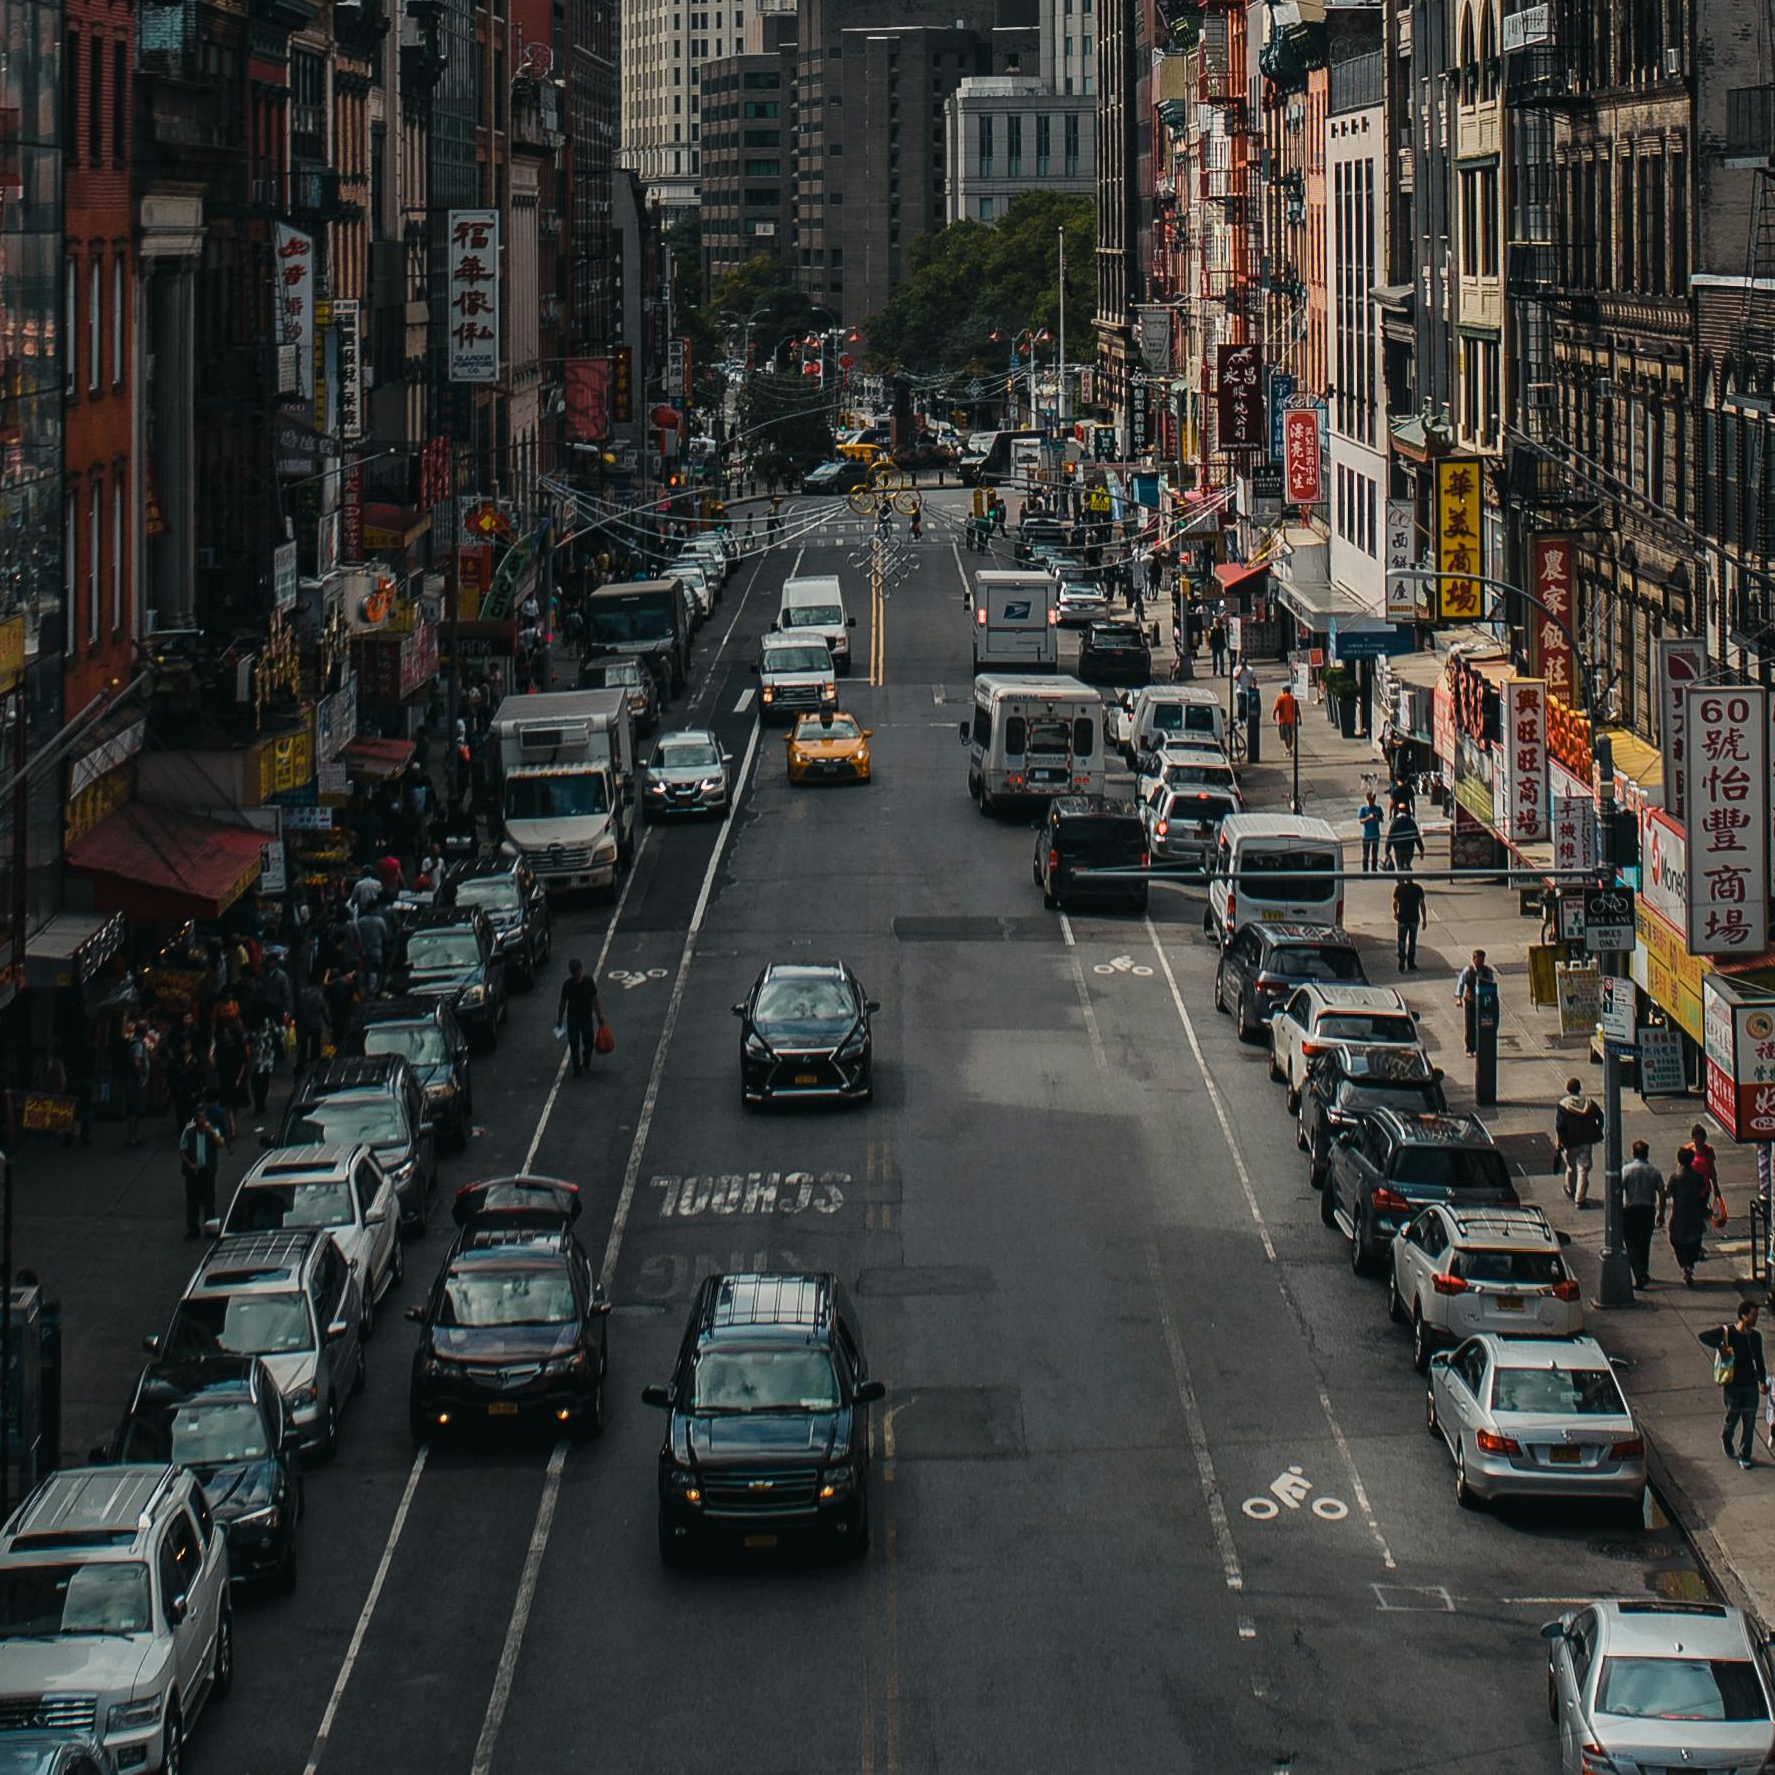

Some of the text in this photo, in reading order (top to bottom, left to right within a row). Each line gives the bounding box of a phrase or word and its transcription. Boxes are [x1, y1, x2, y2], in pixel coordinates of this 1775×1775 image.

[1444, 469, 1479, 615] 華美商場
[1540, 550, 1571, 689] 農家飯莊
[1597, 929, 1623, 938] BIKES
[1598, 938, 1621, 949] ONLY
[649, 1171, 852, 1218] SCHOOL
